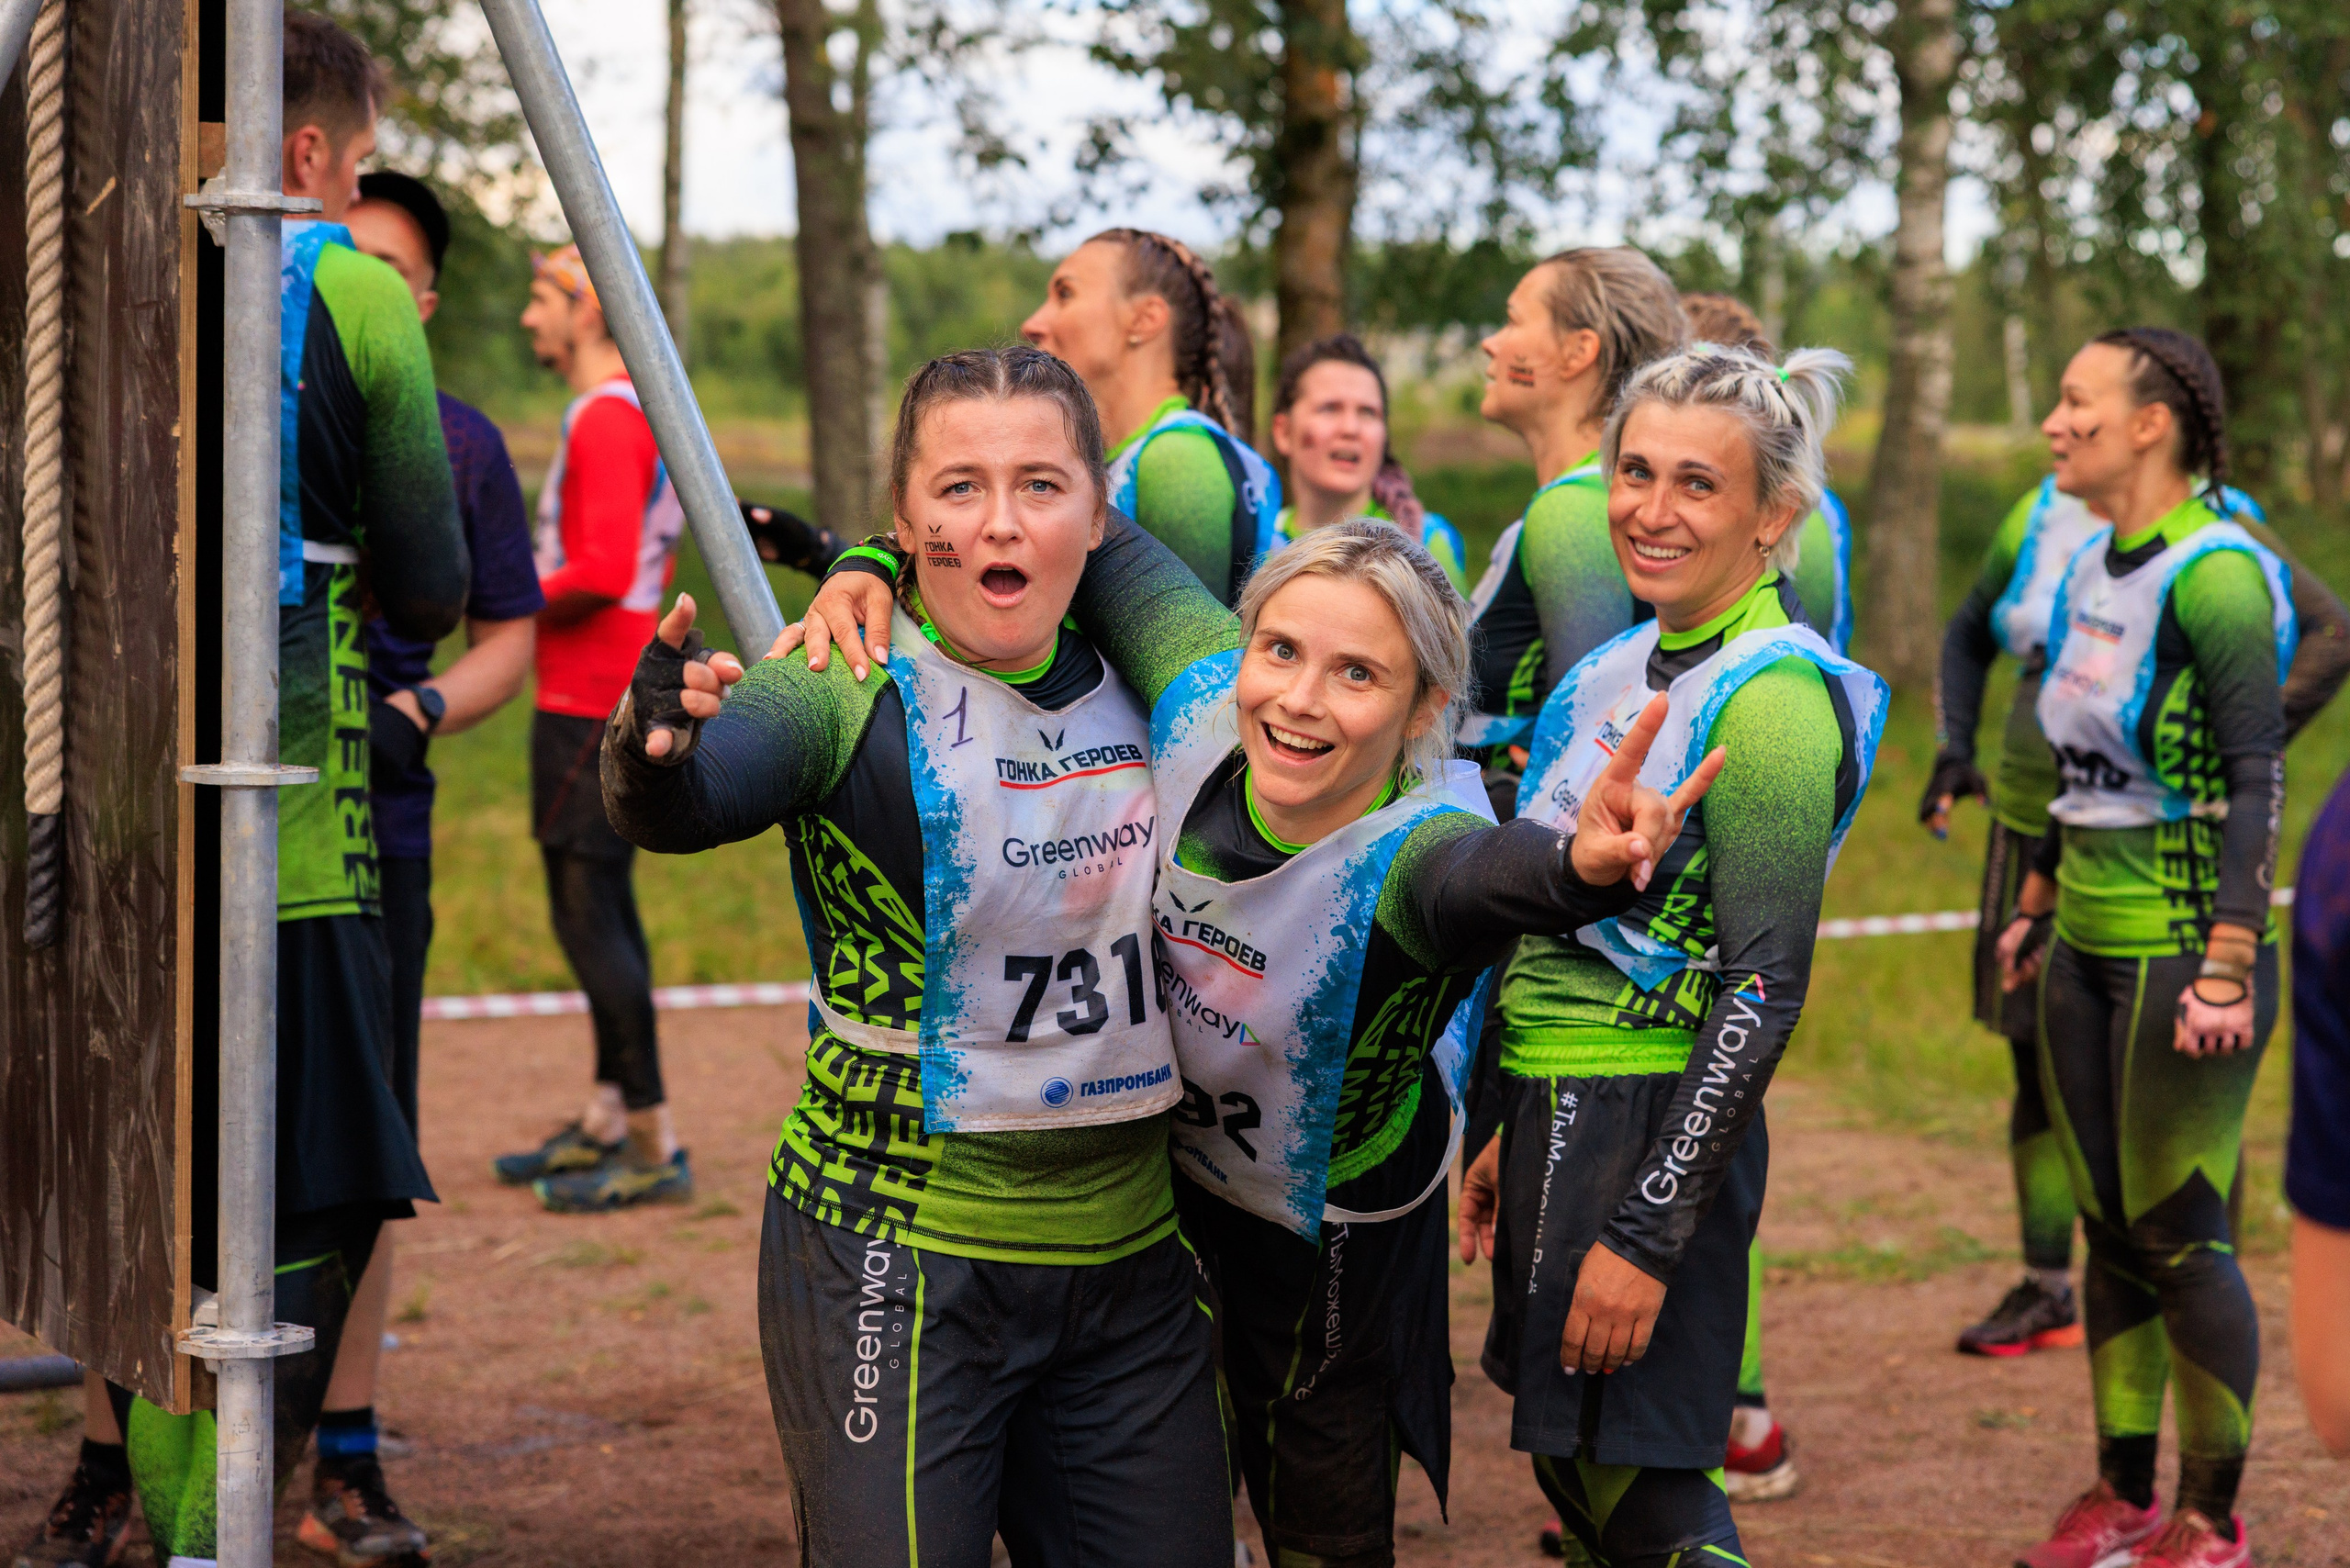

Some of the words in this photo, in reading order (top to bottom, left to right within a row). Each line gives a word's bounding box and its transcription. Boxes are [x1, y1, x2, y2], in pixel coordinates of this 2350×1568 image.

[924, 542, 955, 552] ГОНКА
[927, 557, 962, 568] ГЕРОЕВ
[943, 687, 973, 748] 1
[995, 758, 1058, 782] ГОНКА
[1058, 744, 1143, 772] ГЕРОЕВ
[1002, 816, 1155, 868] Greenway
[1058, 857, 1124, 879] GLOBAL
[1182, 920, 1267, 972] ГЕРОЕВ
[1161, 960, 1240, 1038] enway
[1169, 998, 1203, 1034] OBAL
[1080, 1063, 1172, 1097] ГАЗПРОМБАНК
[1641, 998, 1762, 1204] Greenway
[1711, 1057, 1759, 1152] GLOBAL
[889, 1273, 908, 1369] GLOBAL
